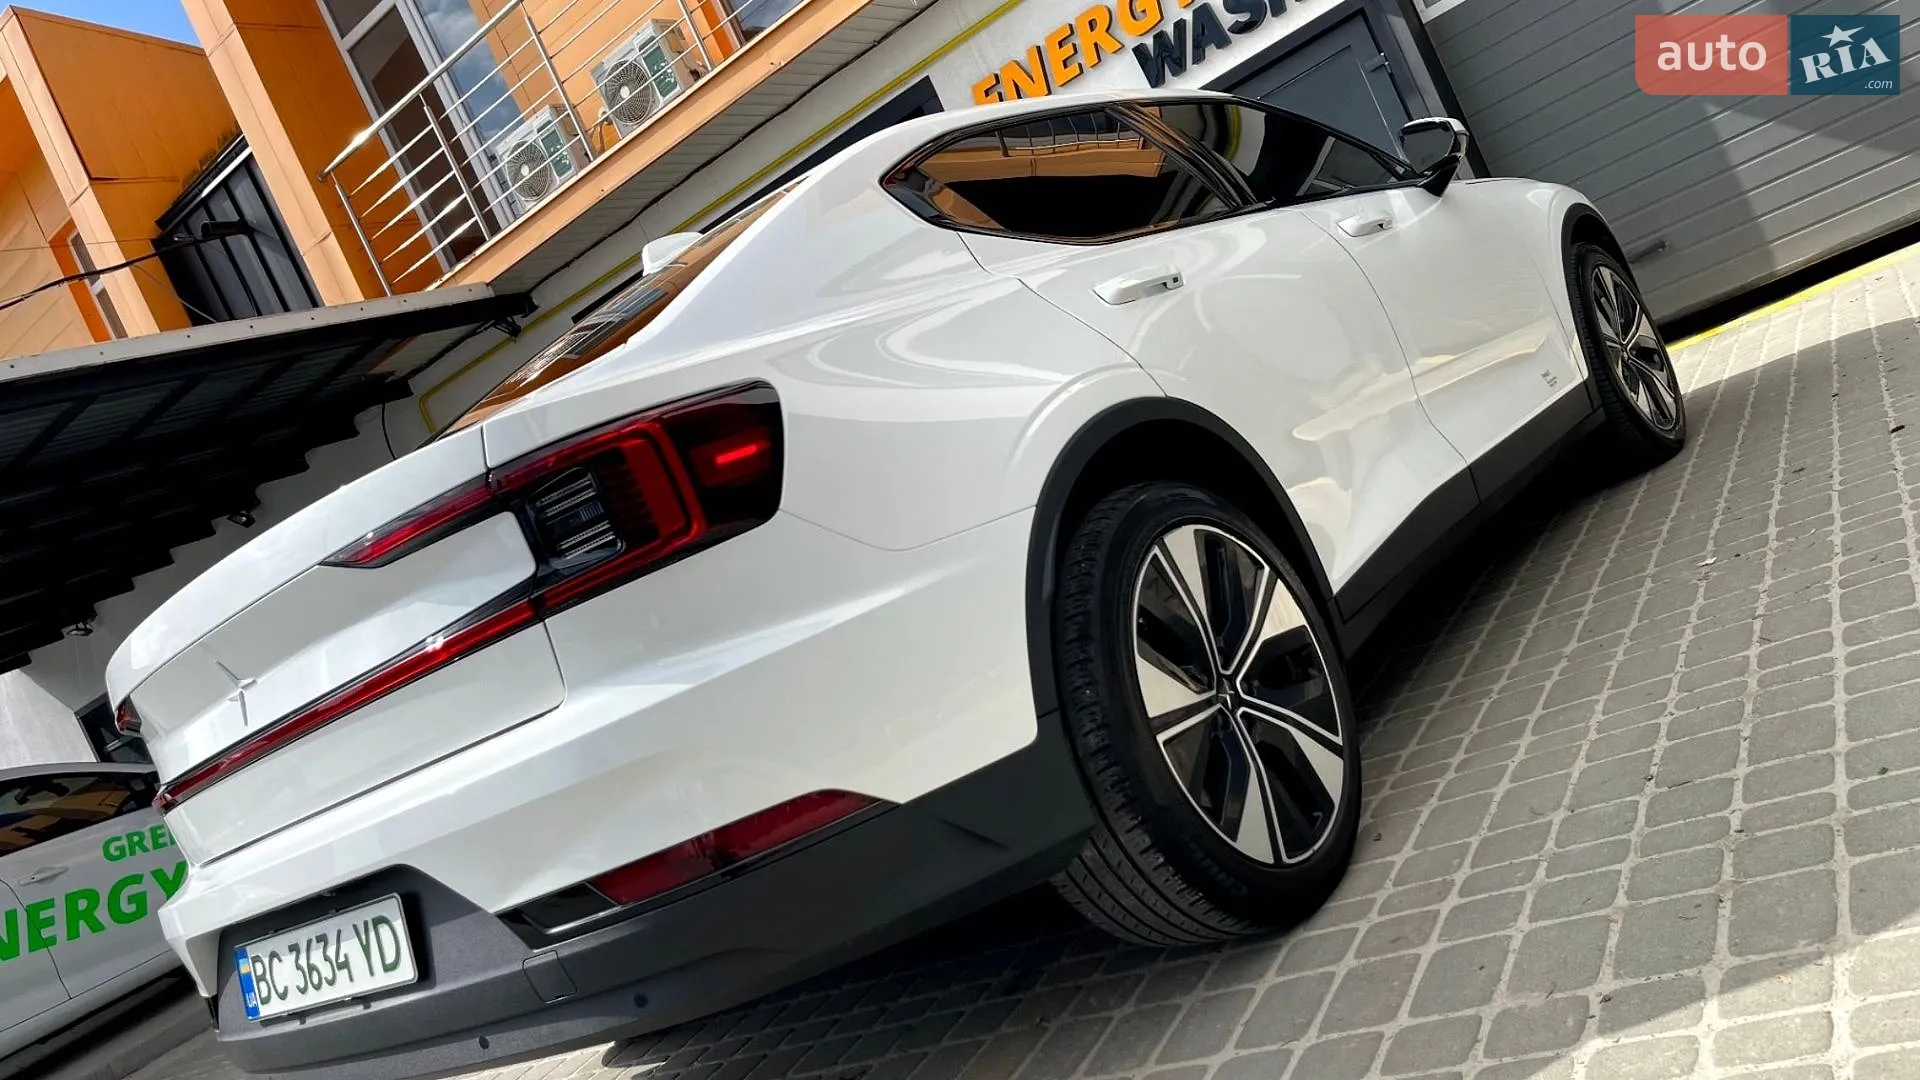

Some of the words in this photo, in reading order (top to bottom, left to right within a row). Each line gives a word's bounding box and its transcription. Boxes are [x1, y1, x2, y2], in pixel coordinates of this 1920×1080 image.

[971, 0, 1197, 105] ENERG
[102, 824, 177, 862] GRE
[251, 950, 288, 1006] BC
[288, 928, 354, 995] 3634
[352, 914, 400, 977] YD
